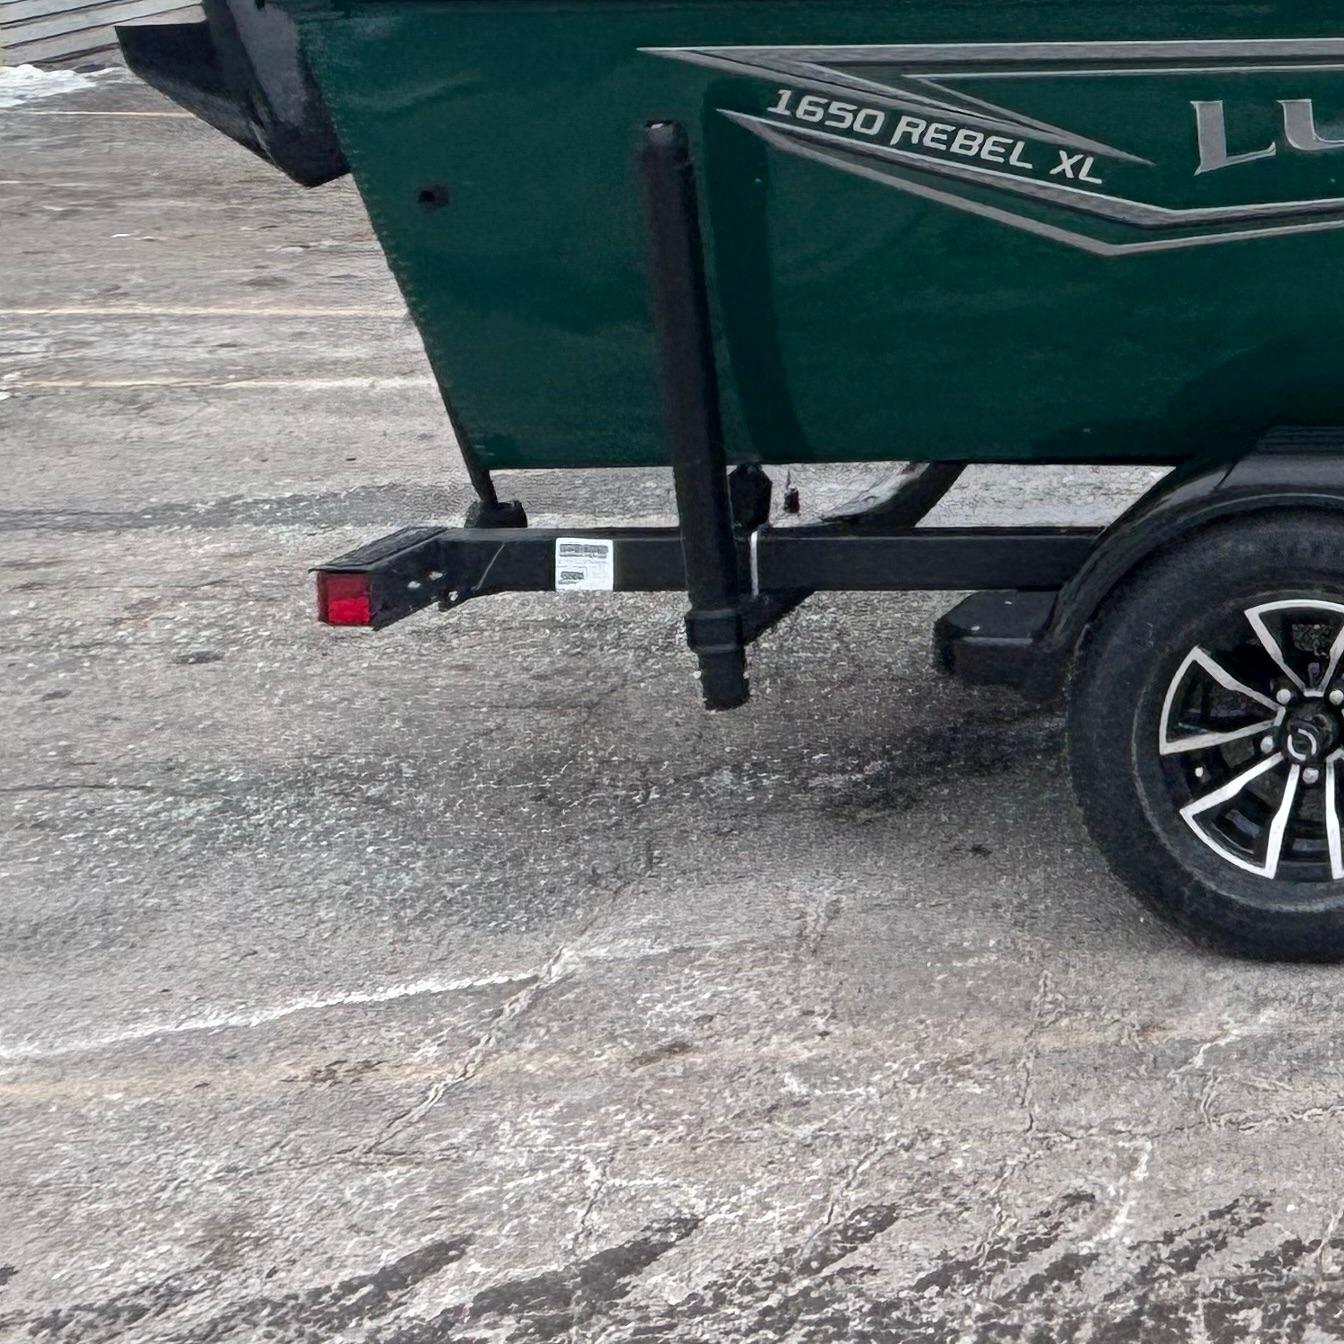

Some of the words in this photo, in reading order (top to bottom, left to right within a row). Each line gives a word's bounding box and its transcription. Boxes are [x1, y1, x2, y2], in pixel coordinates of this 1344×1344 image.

[767, 89, 886, 136] 1650
[889, 115, 1033, 170] REBEL
[1049, 149, 1103, 185] XL
